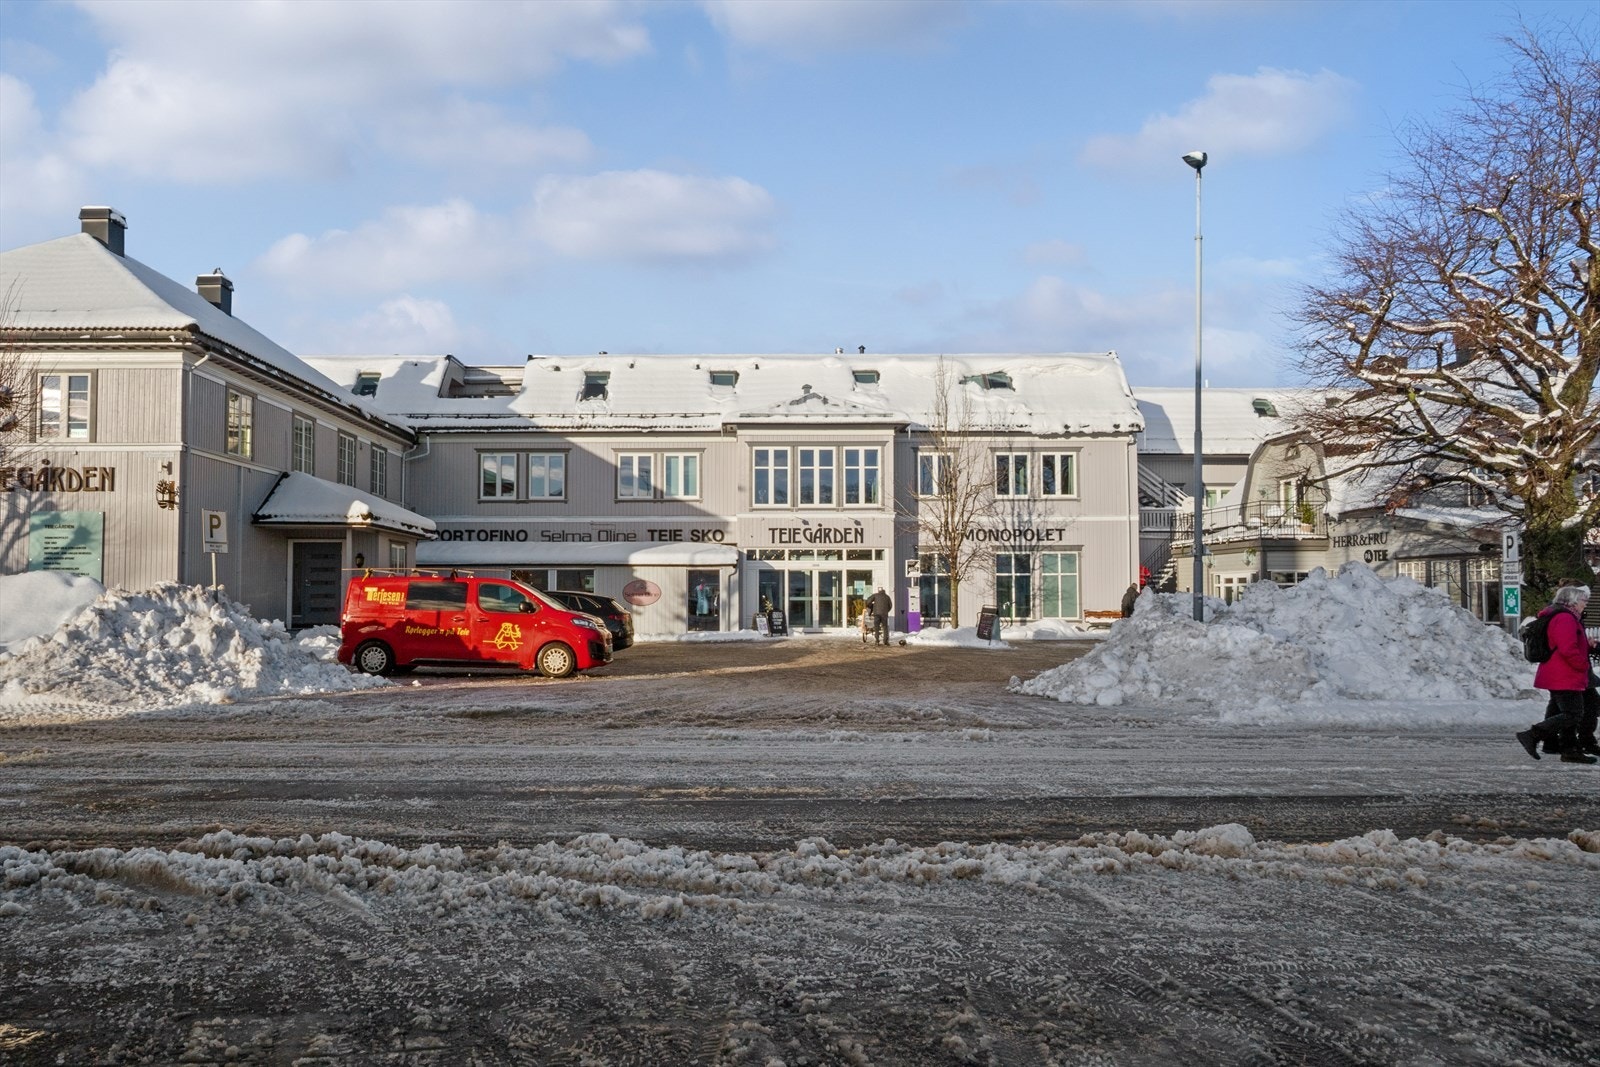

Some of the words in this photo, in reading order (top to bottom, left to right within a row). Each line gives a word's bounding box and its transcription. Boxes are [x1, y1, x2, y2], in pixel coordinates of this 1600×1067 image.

[209, 514, 222, 539] P
[768, 523, 864, 544] TEIEGÅRDEN
[541, 530, 592, 542] Selma
[598, 530, 637, 542] Oline
[647, 529, 684, 542] TEIE
[690, 529, 725, 543] SKO
[932, 528, 1066, 542] VMONOPOLET
[1506, 535, 1514, 558] P
[1373, 550, 1389, 562] TEIE
[364, 587, 401, 603] Terjesen
[457, 627, 470, 636] Teie
